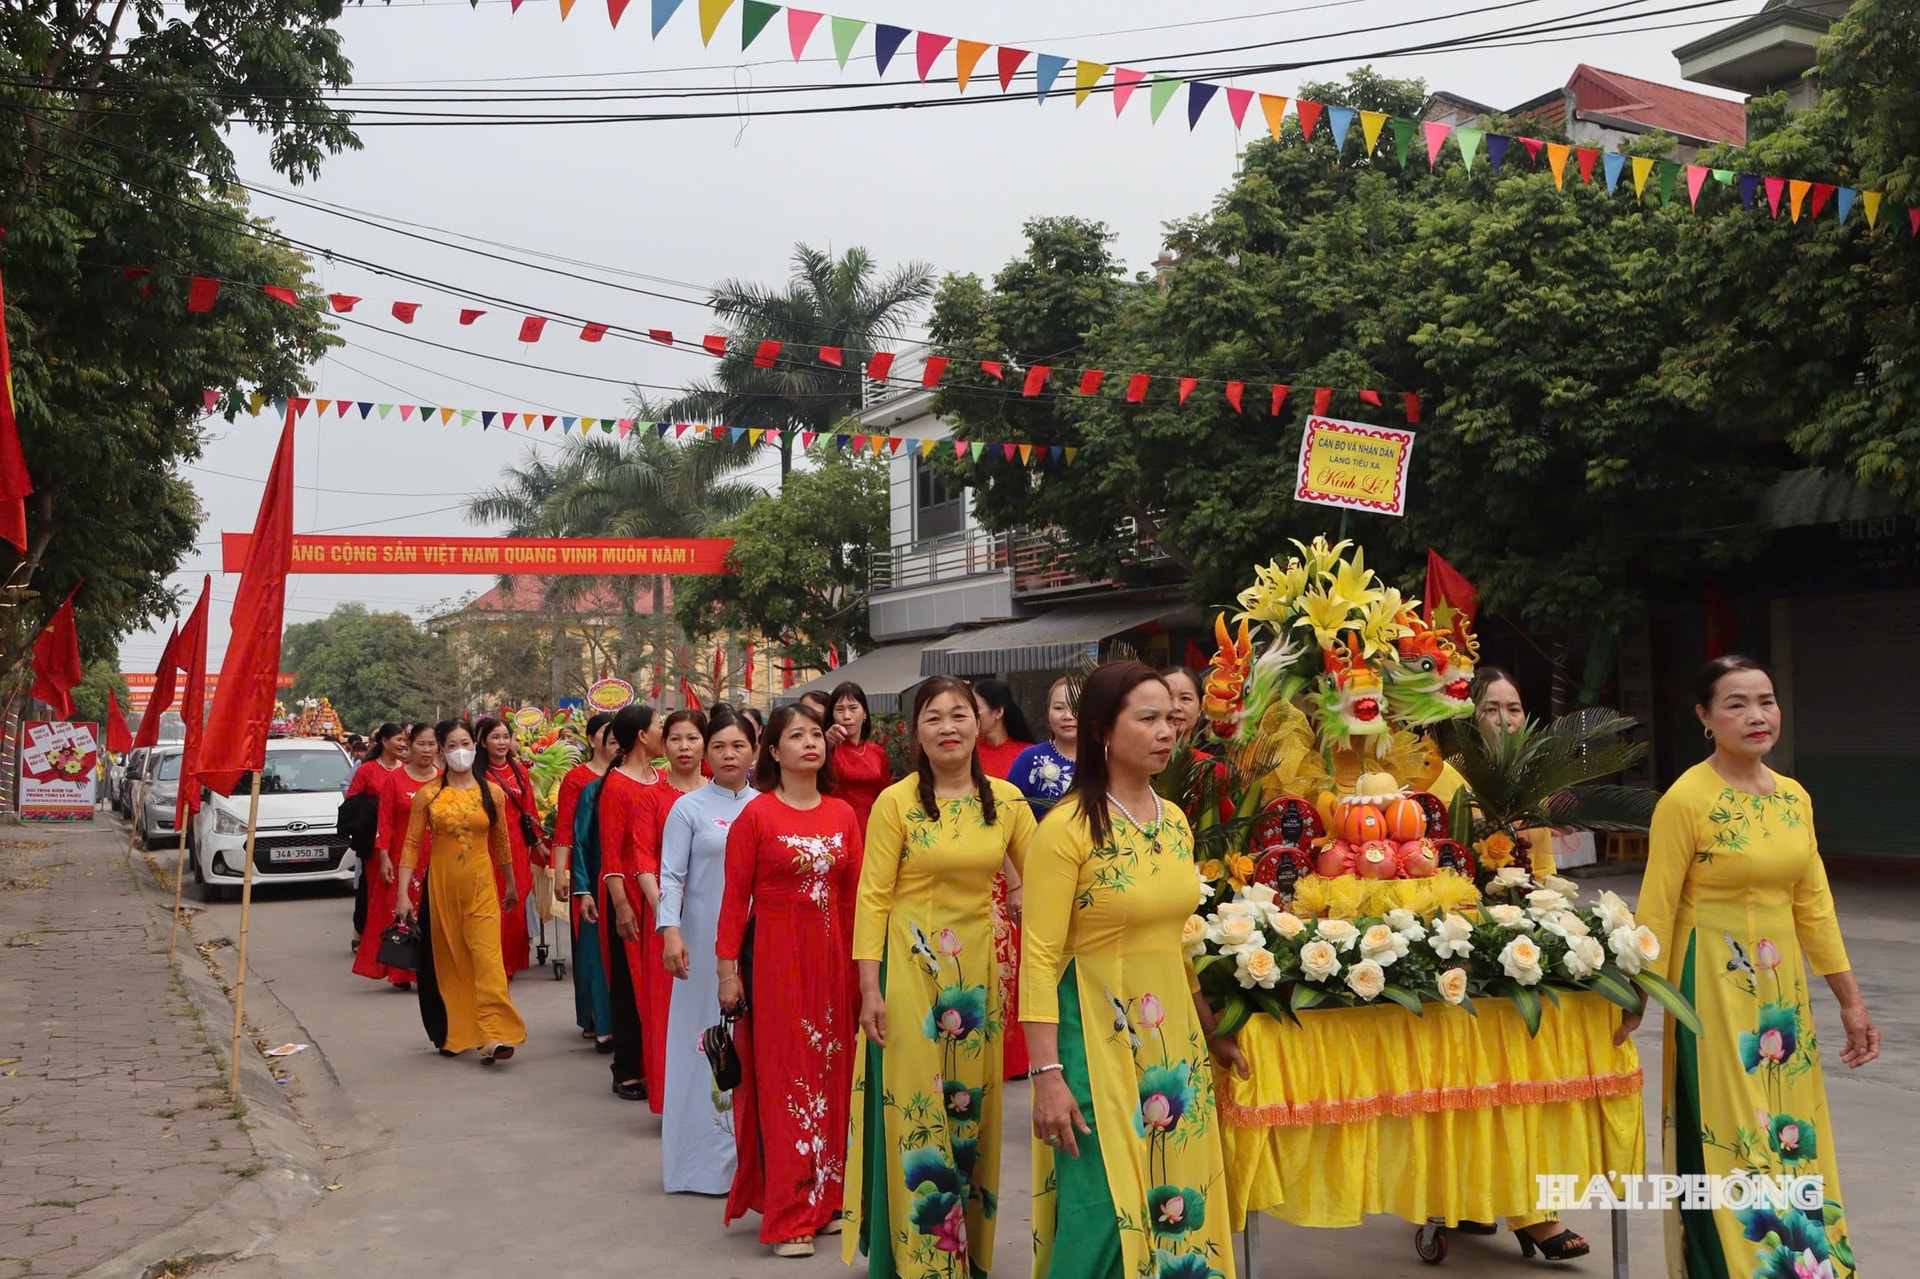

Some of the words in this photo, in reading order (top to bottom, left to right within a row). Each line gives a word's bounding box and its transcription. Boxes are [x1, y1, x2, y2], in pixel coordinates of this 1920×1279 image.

[291, 539, 325, 562] ẢNG
[330, 541, 377, 566] CỘNG
[382, 540, 417, 562] SẢN
[422, 543, 457, 566] VIỆT
[462, 547, 498, 563] NAM
[504, 547, 557, 564] QUANG
[561, 547, 597, 563] VINH
[602, 544, 647, 563] MUÔN
[652, 545, 686, 563] NĂM
[275, 849, 325, 858] 34A-350.75
